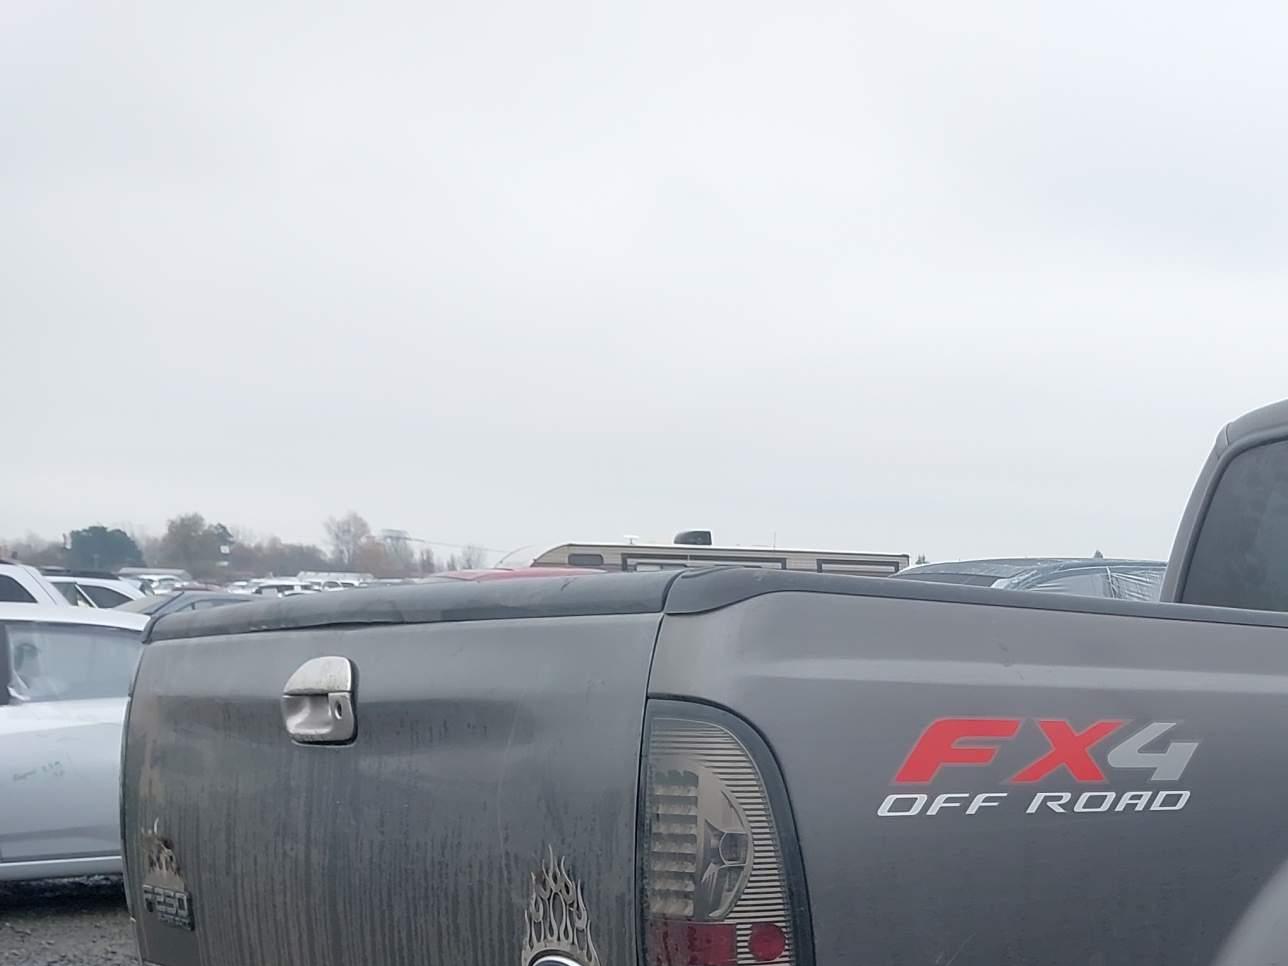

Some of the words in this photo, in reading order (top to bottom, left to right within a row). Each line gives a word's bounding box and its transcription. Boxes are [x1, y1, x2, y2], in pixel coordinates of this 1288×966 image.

[894, 718, 1200, 784] FX4
[877, 792, 1008, 817] OFF
[1025, 790, 1191, 814] ROAD
